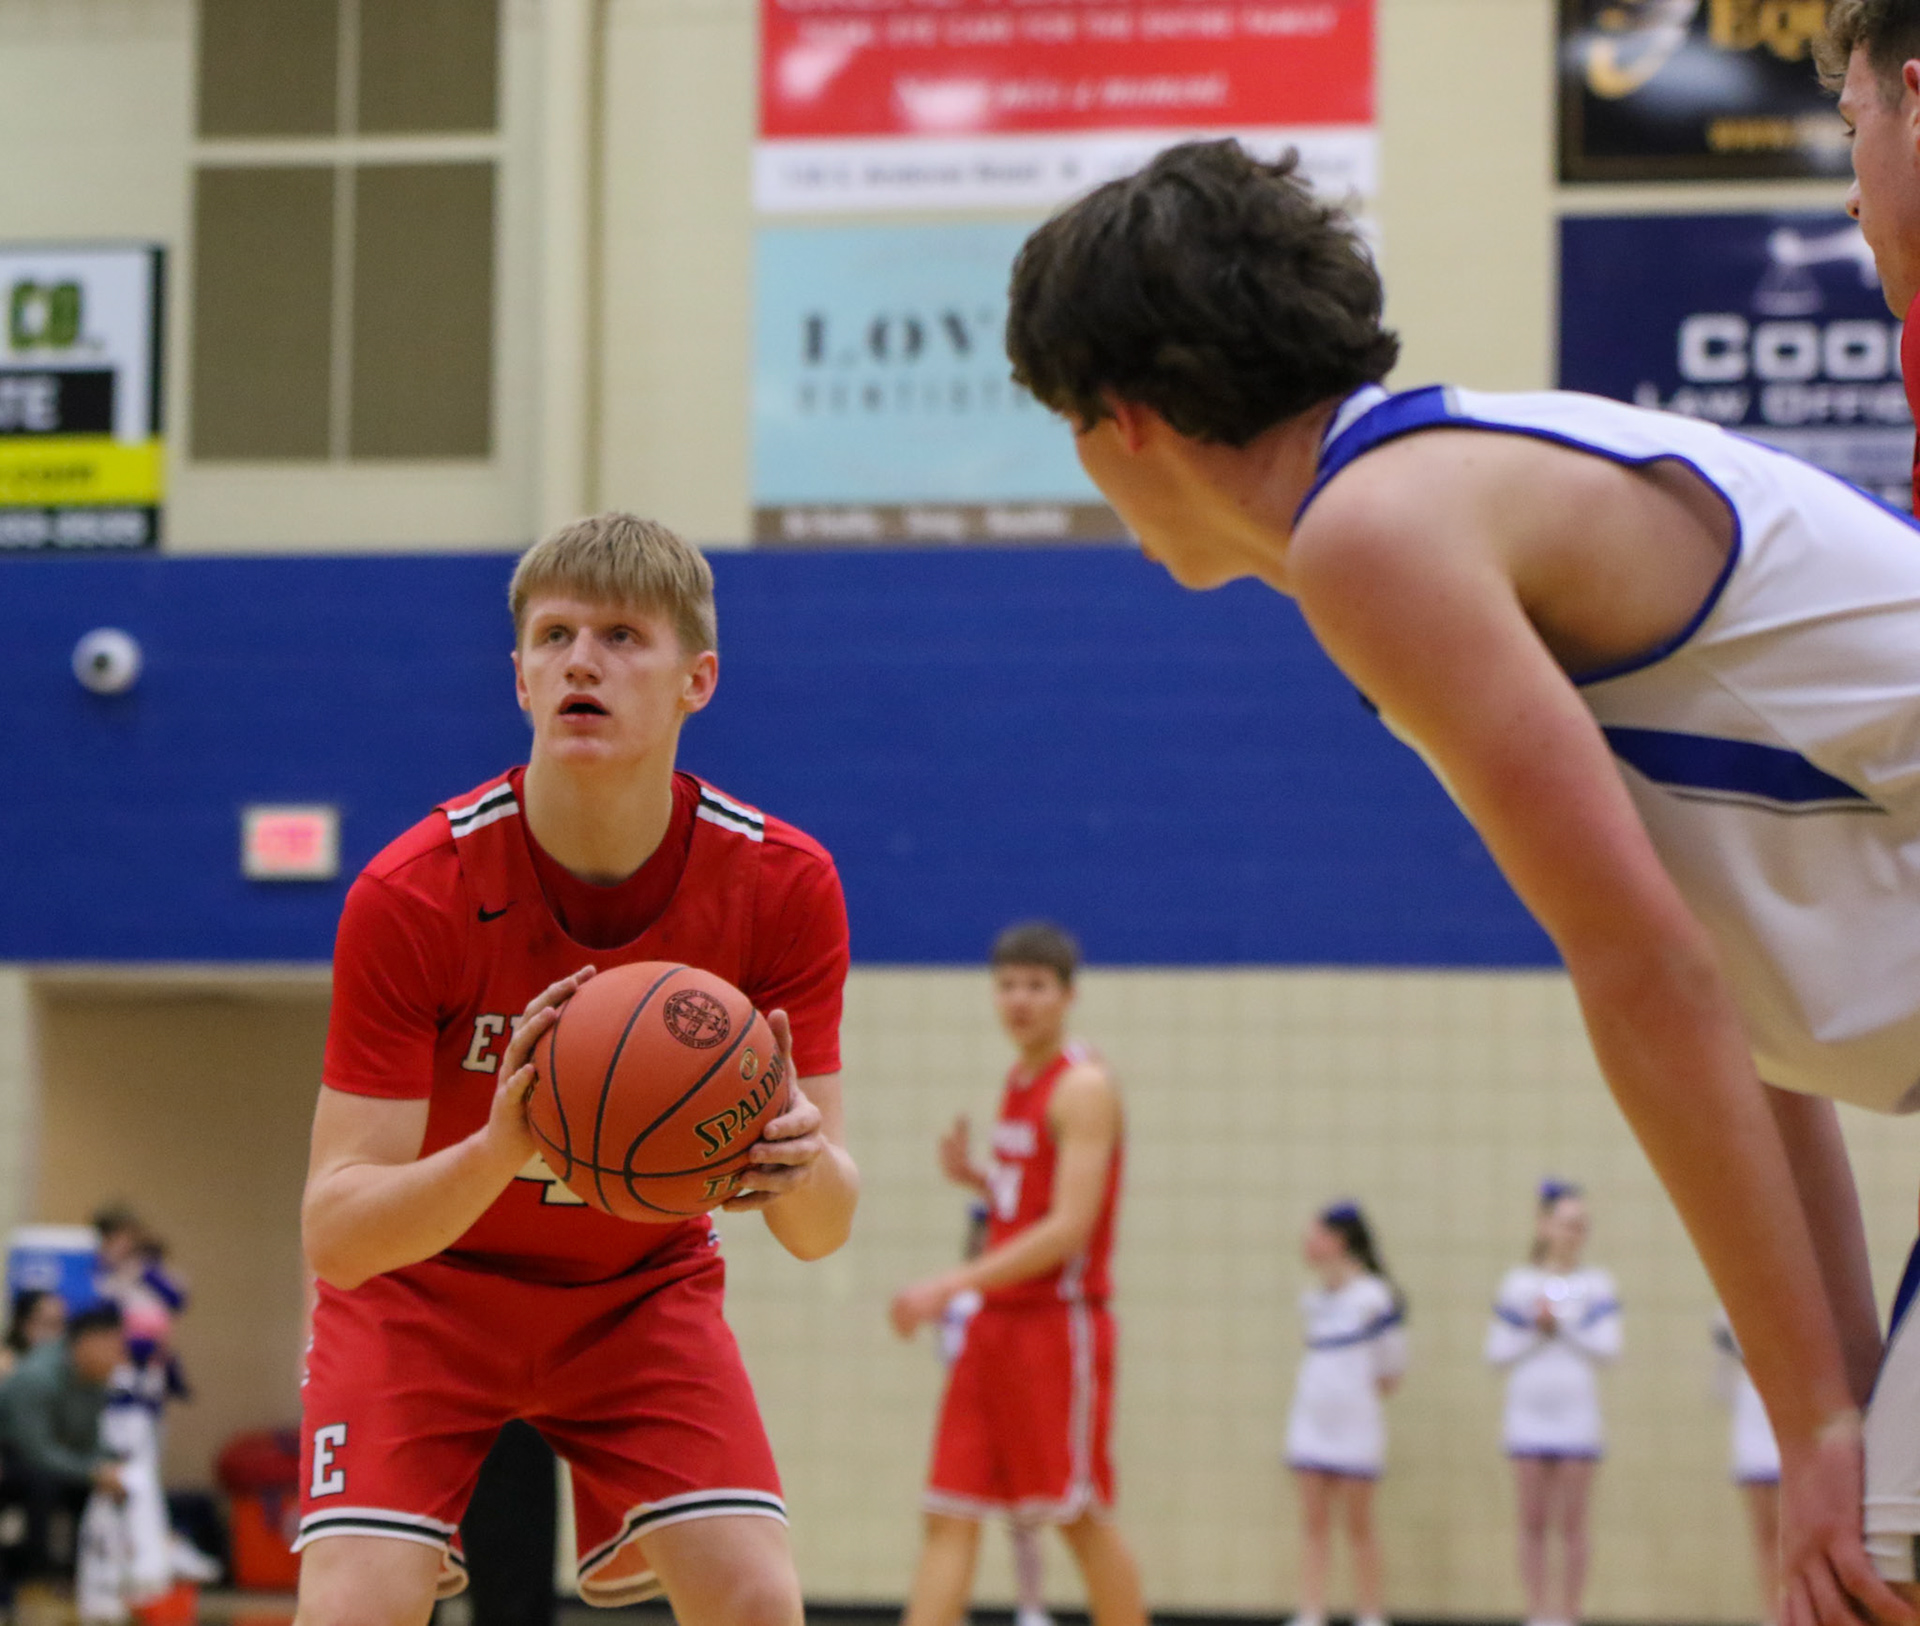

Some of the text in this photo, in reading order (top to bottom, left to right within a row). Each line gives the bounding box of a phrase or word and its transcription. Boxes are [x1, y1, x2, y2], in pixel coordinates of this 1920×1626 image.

[1679, 314, 1905, 382] COO
[693, 1052, 785, 1159] SPALDIN
[309, 1421, 348, 1499] E
